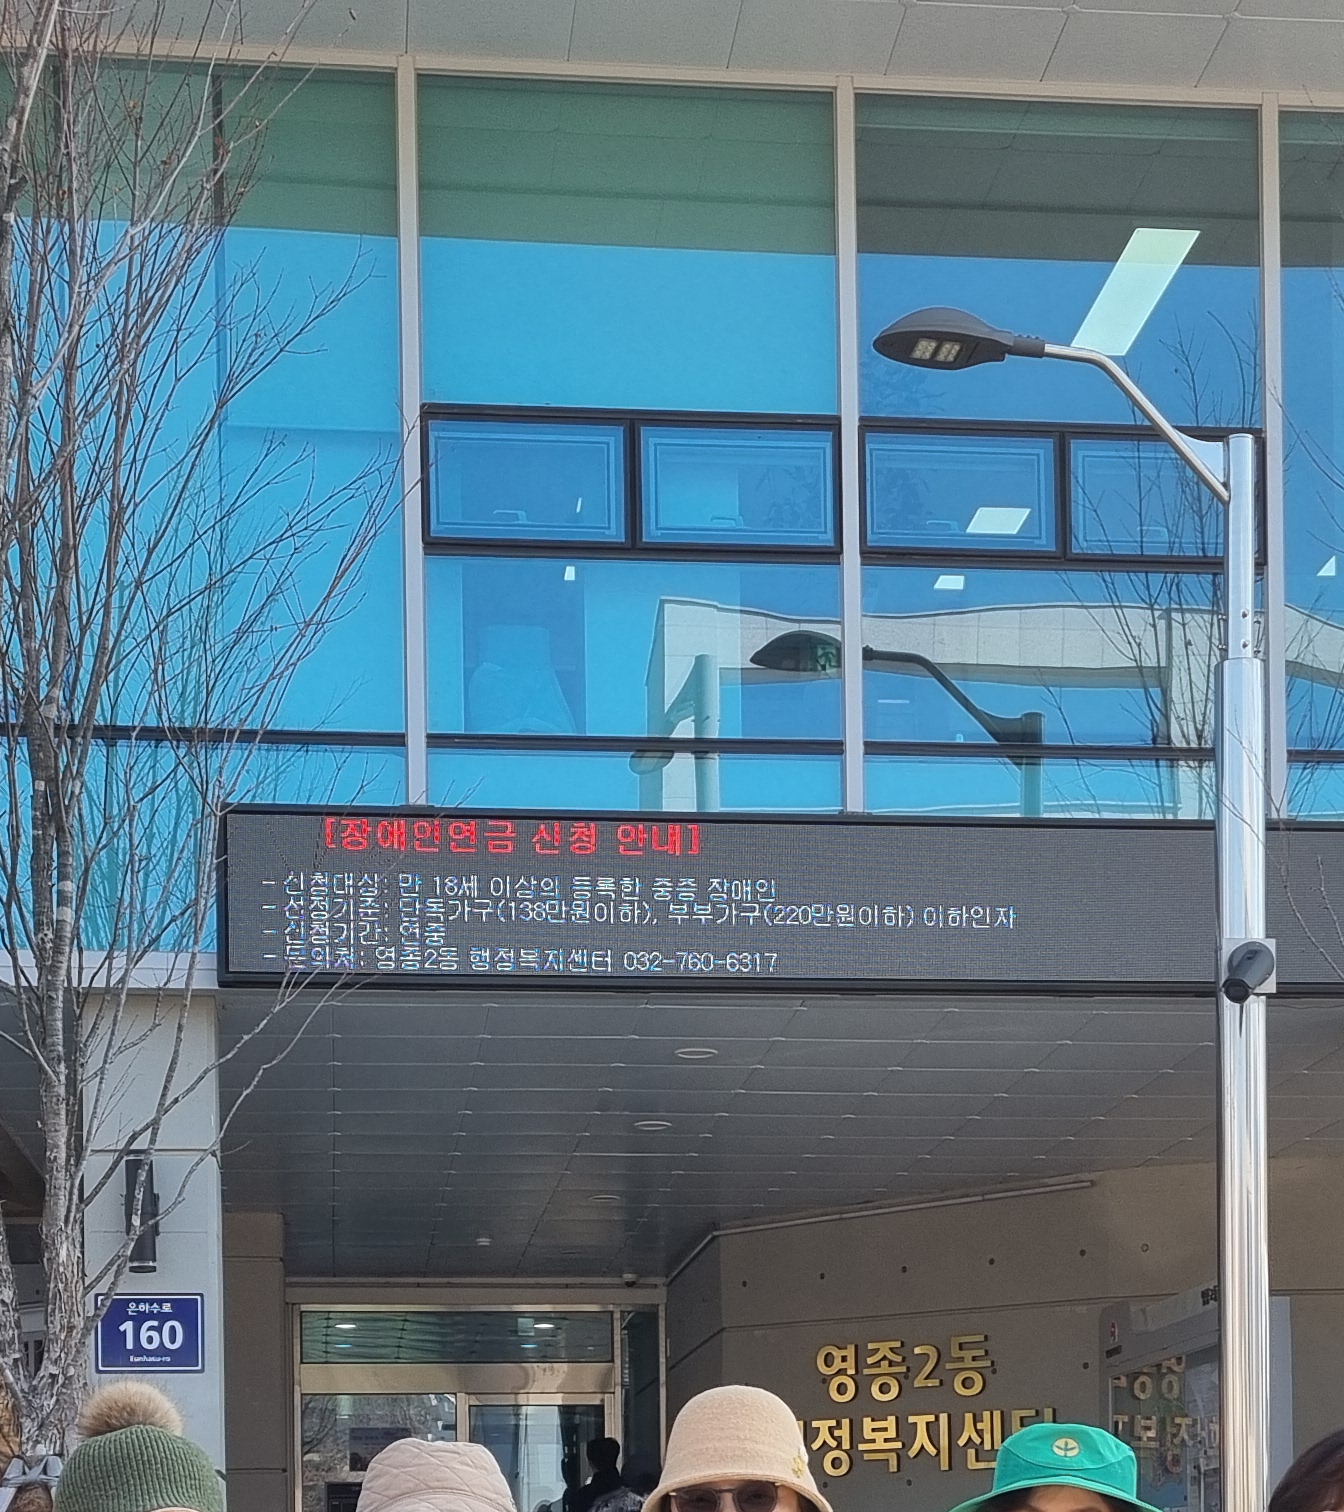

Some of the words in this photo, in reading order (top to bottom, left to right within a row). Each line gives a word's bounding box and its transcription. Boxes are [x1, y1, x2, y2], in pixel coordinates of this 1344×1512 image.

[324, 817, 517, 853] [장애인연금
[532, 822, 597, 854] 신청
[617, 824, 700, 855] 안내]
[399, 873, 422, 897] 만
[434, 874, 477, 898] 18세
[490, 875, 559, 899] 이상의
[571, 876, 642, 901] 등록한
[651, 878, 699, 901] 중증
[707, 878, 776, 902] 장애인
[923, 905, 1017, 929] 이하인자
[469, 947, 613, 972] 행정복지센터
[624, 951, 778, 973] 032-760-6317
[126, 1302, 173, 1315] 은하수로
[118, 1320, 183, 1350] 160
[816, 1334, 994, 1403] 영종2동
[799, 1407, 1056, 1477] 정복지센
